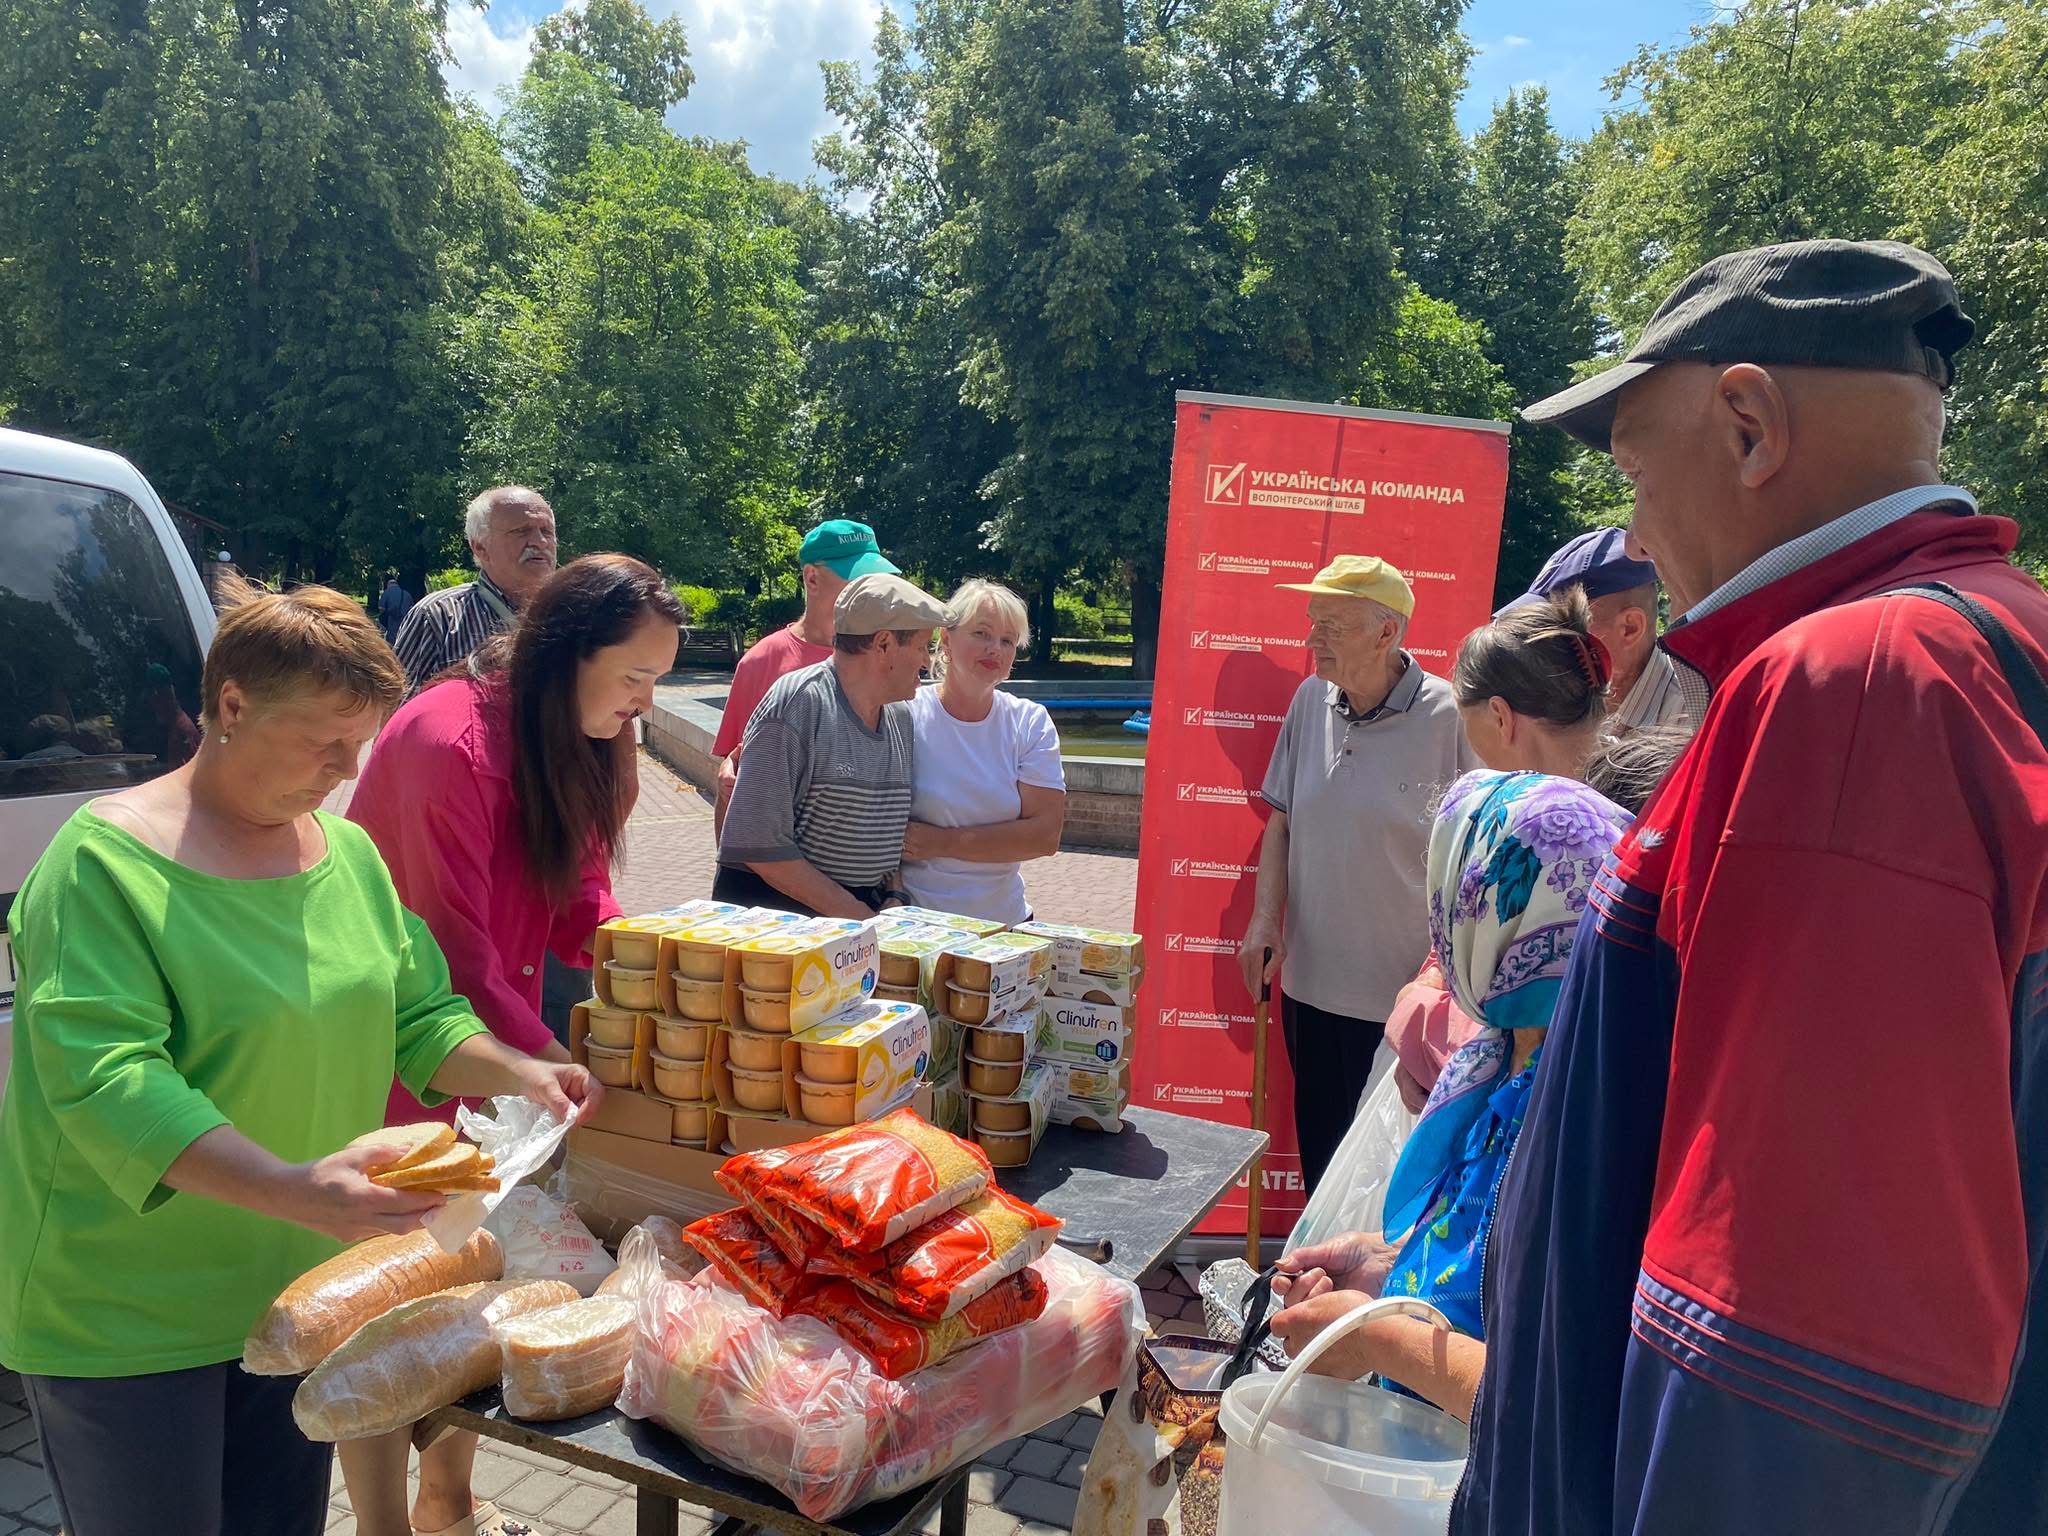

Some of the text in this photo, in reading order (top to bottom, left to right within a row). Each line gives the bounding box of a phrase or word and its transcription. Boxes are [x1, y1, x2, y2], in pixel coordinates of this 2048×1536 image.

[1250, 470, 1465, 504] УКРАЇНСЬКА КОМАНДА
[1252, 492, 1360, 510] ВОЛОНТЕРСЬКИЙ ШТАБ
[1217, 555, 1270, 566] УКРАЇНСЬКА
[1271, 559, 1314, 570] КОМАНДА
[1415, 570, 1456, 581] КОМАНДА
[1210, 633, 1262, 644] УКРАЇНСЬКА
[1264, 637, 1306, 648] КОМАНДА
[1203, 710, 1255, 721] УКРАЇНСЬКА
[1196, 785, 1248, 796] УКРАЇНСЬКА
[1190, 861, 1242, 872] УКРАЇНСЬКА
[1184, 936, 1235, 946] УКРАЇНСЬКА
[834, 943, 875, 969] Clinutren
[1056, 1010, 1118, 1032] Clinutren
[1179, 1011, 1273, 1024] УКРАЇНСЬКА КОМАА
[892, 1025, 928, 1056] Clinutren
[1173, 1086, 1224, 1096] УКРАЇНСЬКА
[1193, 1395, 1219, 1405] COFF
[1204, 1457, 1223, 1469] COF
